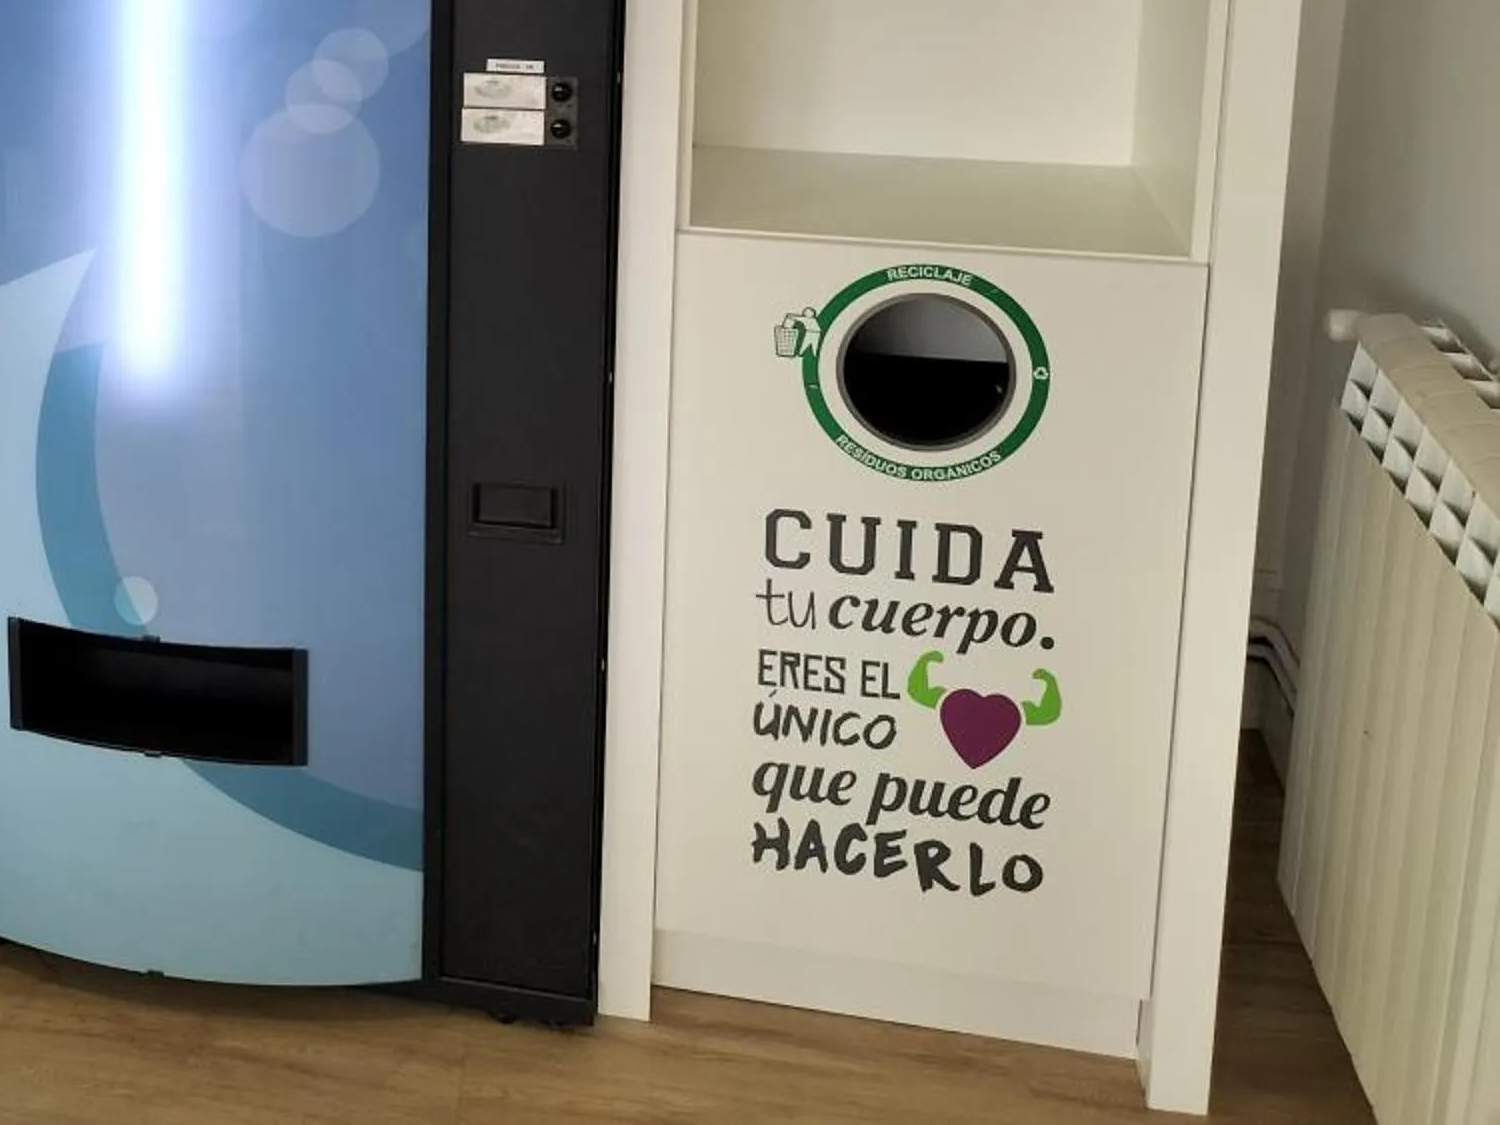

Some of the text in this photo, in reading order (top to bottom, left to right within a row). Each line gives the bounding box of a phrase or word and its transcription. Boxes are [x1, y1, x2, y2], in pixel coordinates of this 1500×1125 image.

[886, 265, 973, 286] RECICLAJE
[765, 508, 1055, 594] CUIDA
[755, 578, 1056, 655] tu cuerpo.
[758, 649, 902, 700] ERES EL
[753, 689, 897, 750] ÚNICO
[751, 761, 1051, 830] que puede
[750, 816, 1045, 897] HACERLO
